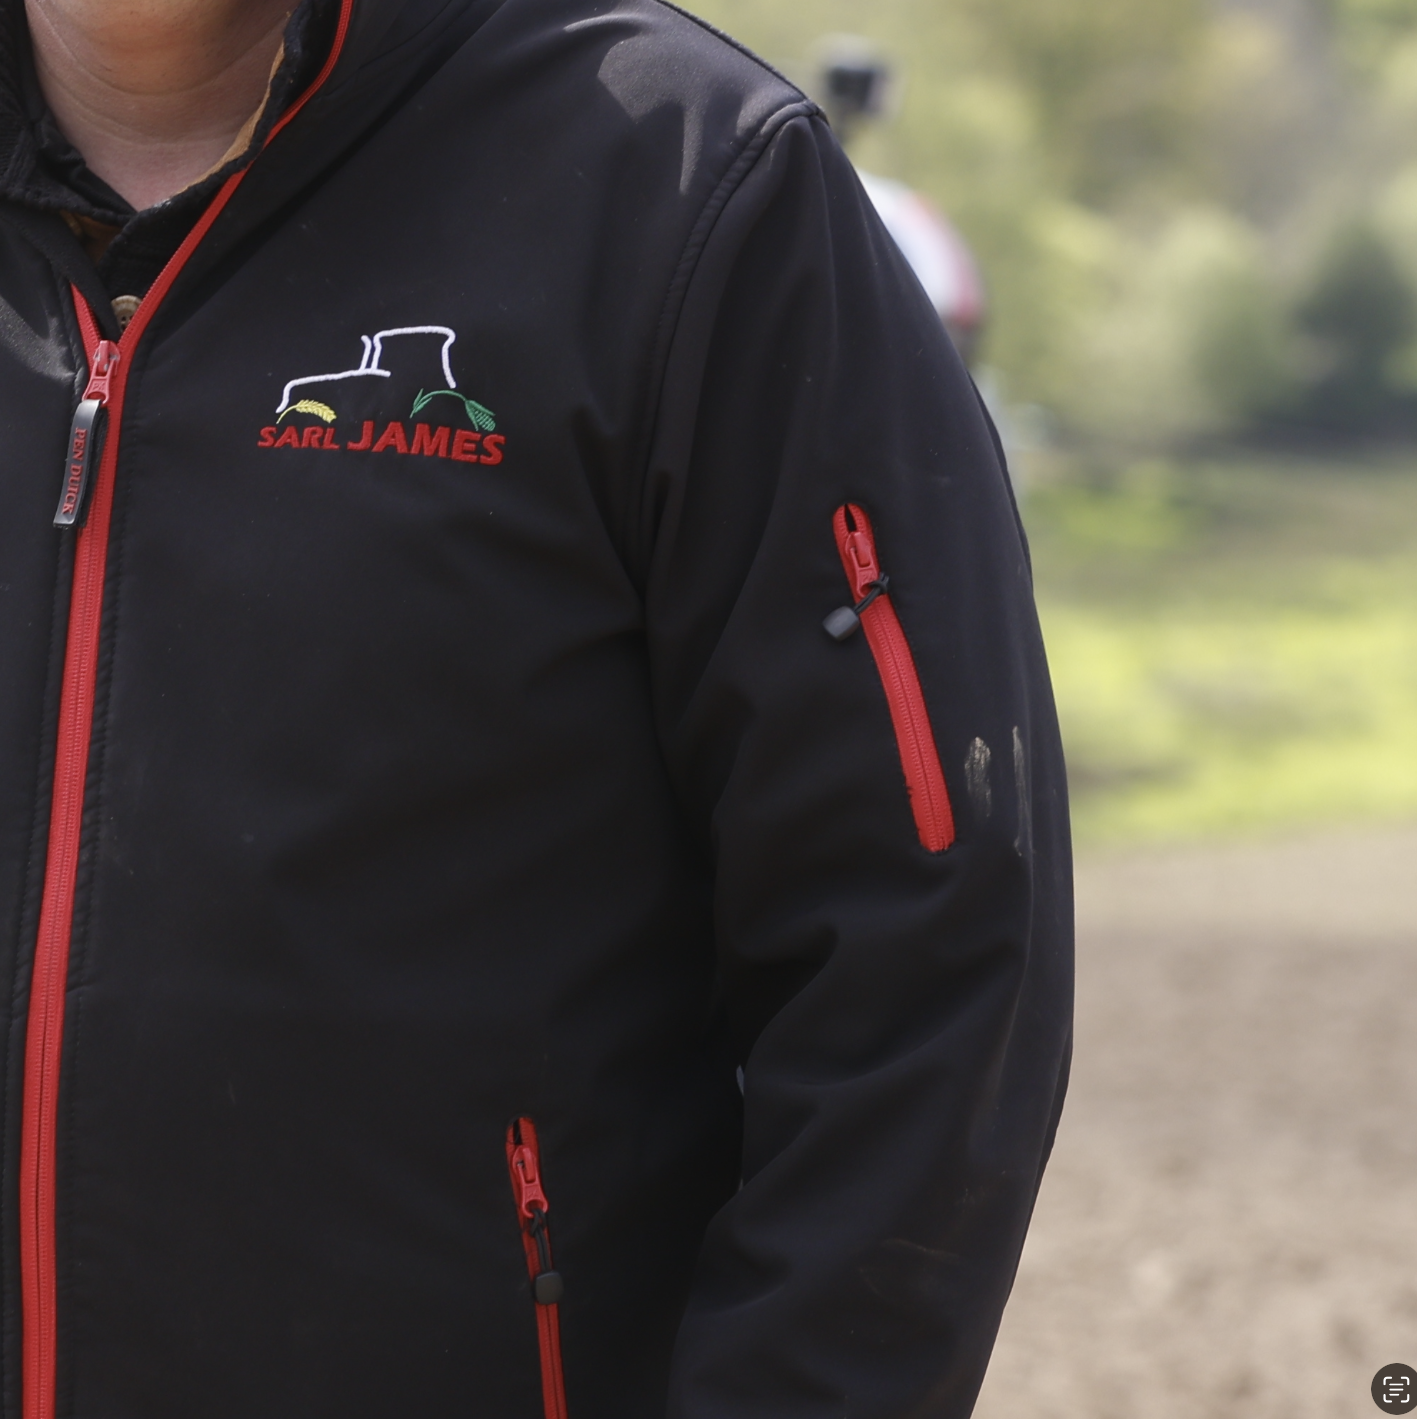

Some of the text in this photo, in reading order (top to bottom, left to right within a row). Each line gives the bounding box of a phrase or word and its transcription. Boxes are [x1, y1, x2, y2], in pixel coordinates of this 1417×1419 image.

[62, 427, 87, 514] PEN DUICK
[258, 421, 506, 465] SARL JAMES
